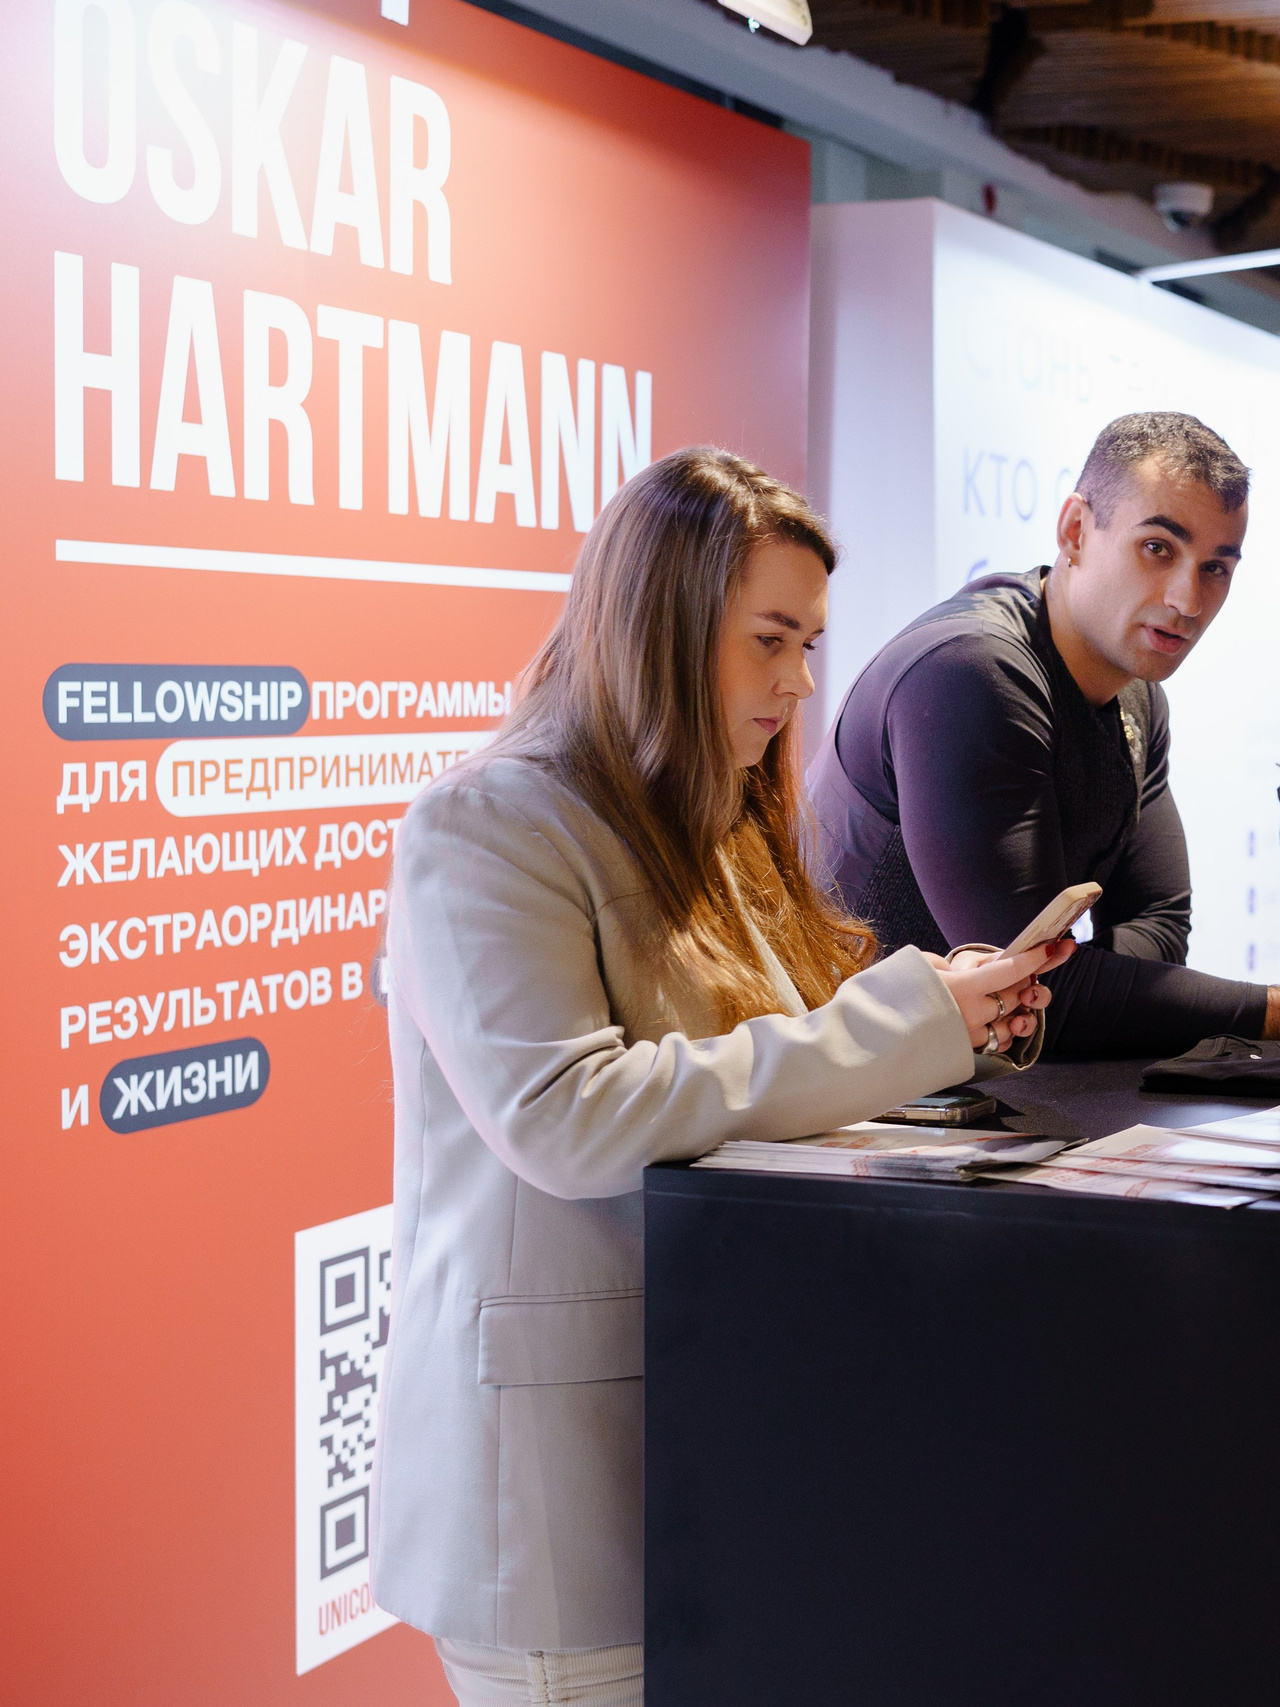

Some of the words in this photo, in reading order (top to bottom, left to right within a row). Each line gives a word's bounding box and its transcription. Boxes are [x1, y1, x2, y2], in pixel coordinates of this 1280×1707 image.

[54, 0, 452, 285] OSKAR
[54, 250, 652, 533] HARTMANN
[58, 681, 302, 724] FELLOWSHIP
[312, 682, 511, 720] ПРОГРАММЫ
[56, 760, 148, 814] ДЛЯ
[57, 827, 307, 887] ЖЕЛАЮЩИХ
[59, 889, 387, 969] ЭКСТРАОРДИНАР
[60, 966, 332, 1050] РЕЗУЛЬТАТОВ
[341, 961, 364, 1001] В
[61, 1084, 89, 1131] И
[112, 1050, 260, 1119] ЖИЗНИ
[319, 1583, 376, 1636] UNICO
